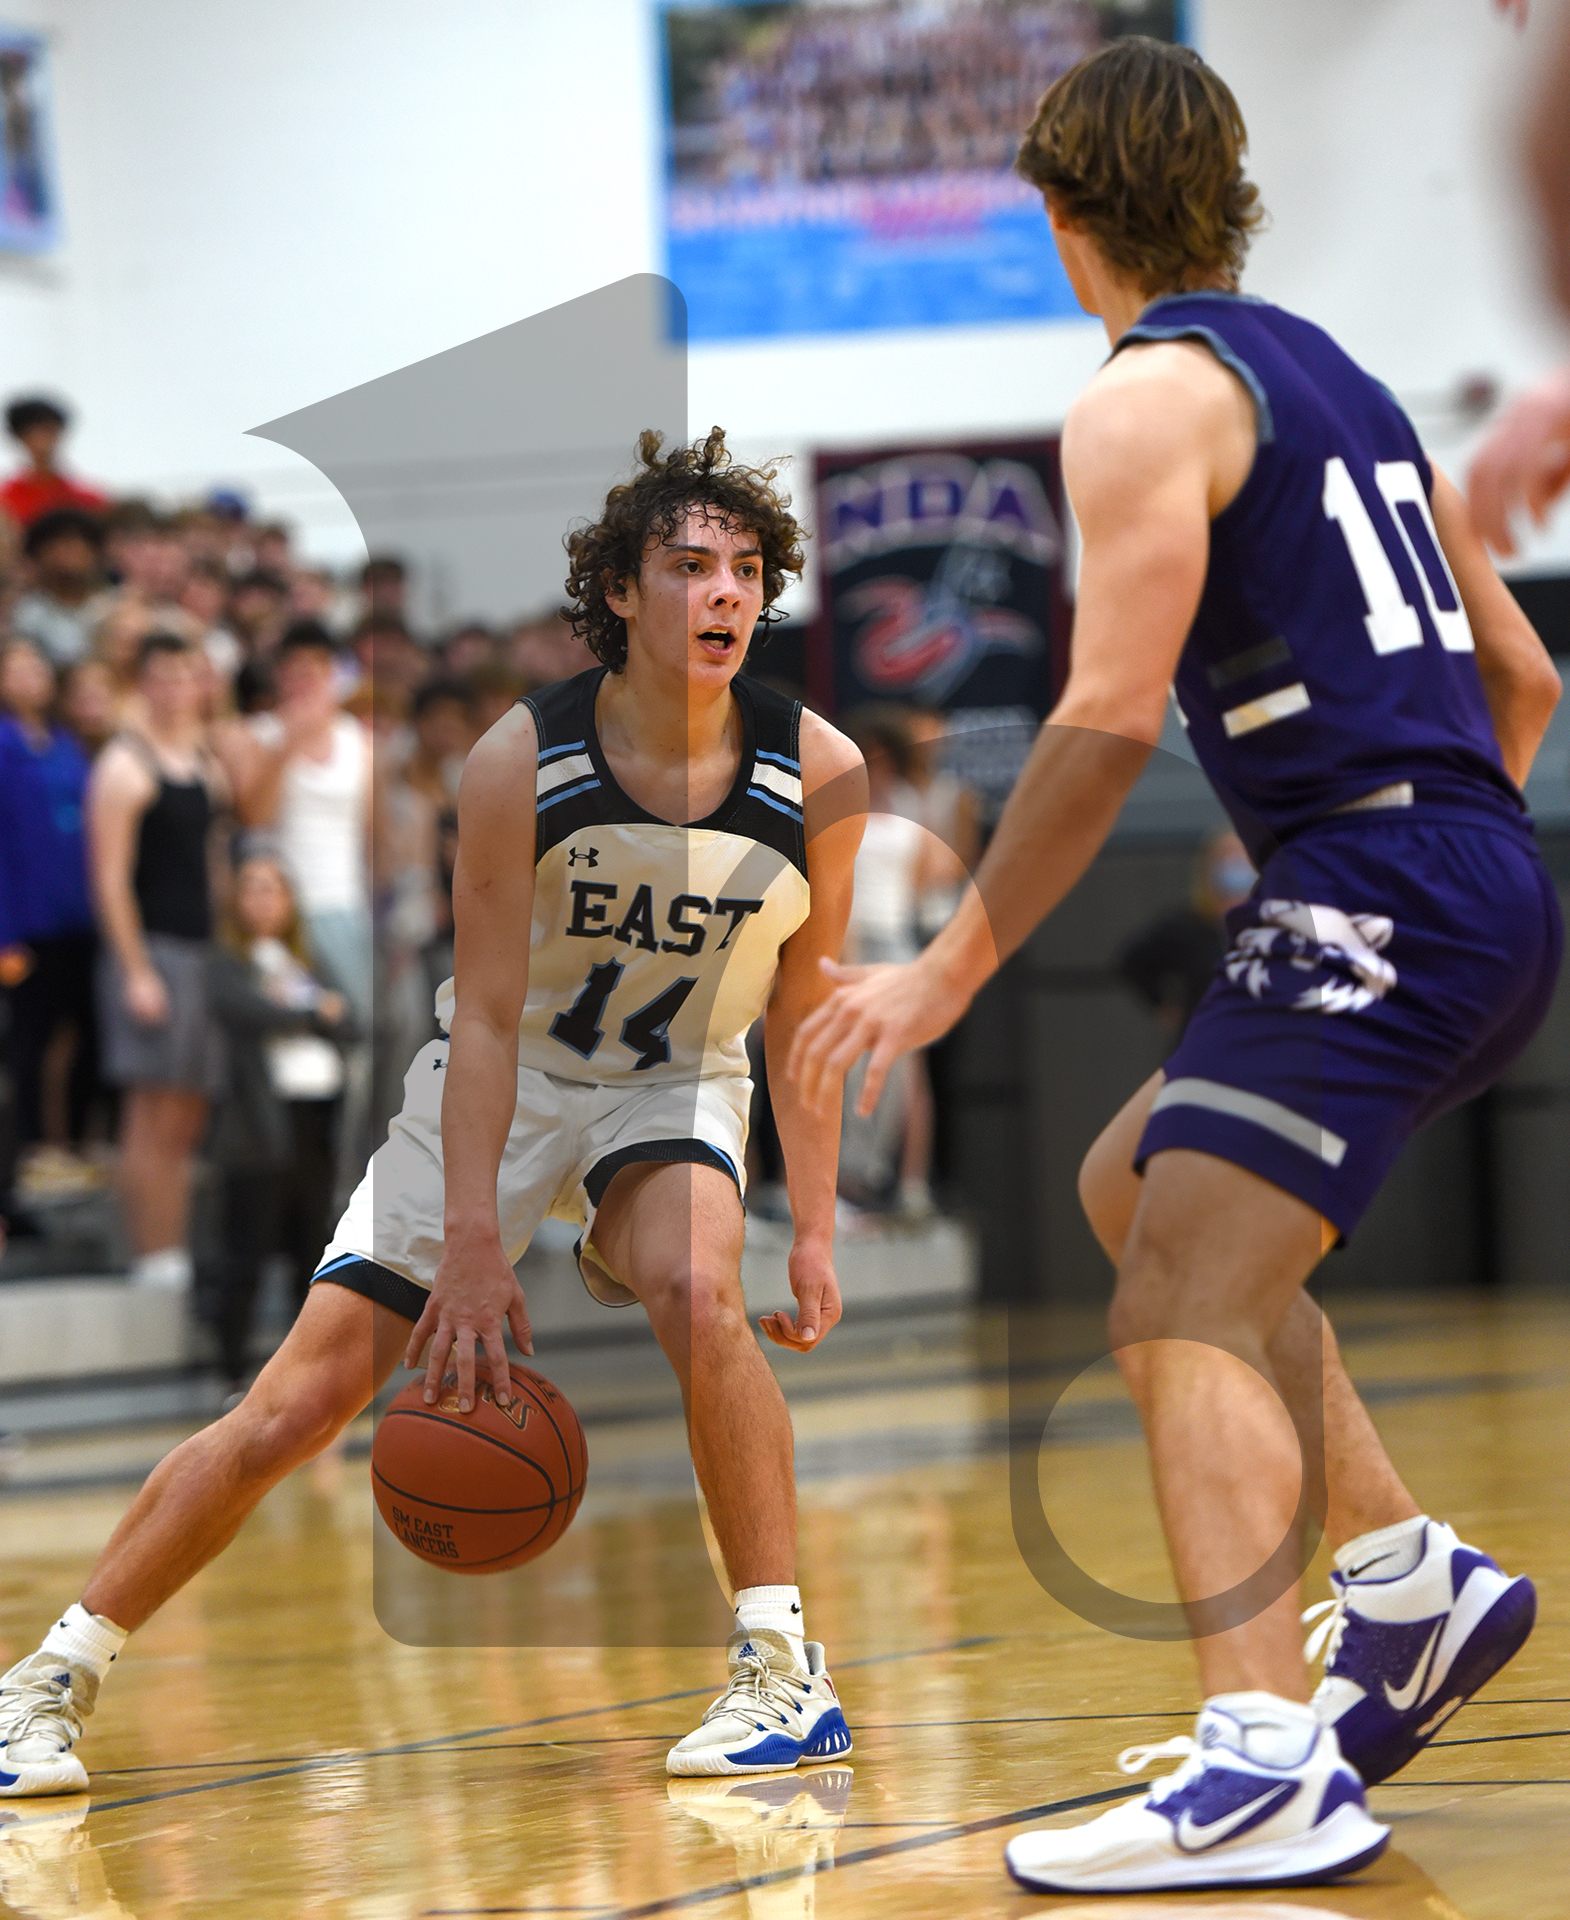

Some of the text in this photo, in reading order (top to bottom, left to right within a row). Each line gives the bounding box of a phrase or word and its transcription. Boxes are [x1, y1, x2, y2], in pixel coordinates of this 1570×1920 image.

[822, 462, 1053, 548] NDA
[1322, 456, 1475, 655] 10
[565, 879, 764, 957] EAST
[547, 957, 699, 1072] 14
[392, 1505, 454, 1539] SM EAST
[394, 1521, 459, 1559] LANCERS
